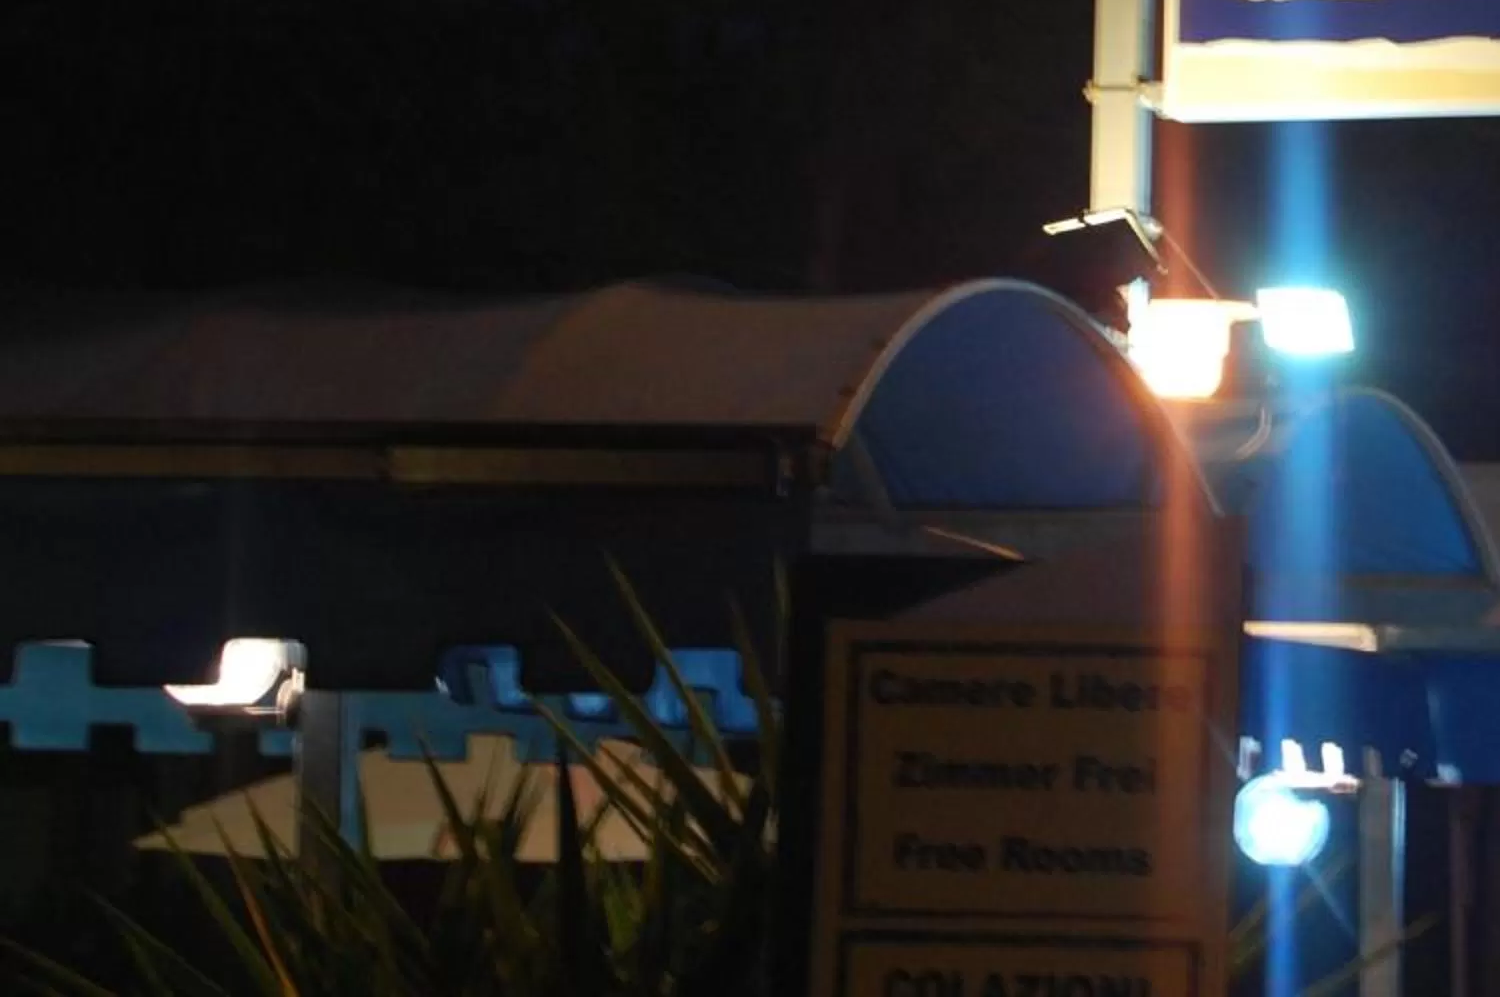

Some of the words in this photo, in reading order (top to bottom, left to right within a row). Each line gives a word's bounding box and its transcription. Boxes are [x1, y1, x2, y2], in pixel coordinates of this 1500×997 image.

[869, 669, 1037, 709] Camere
[891, 750, 1060, 790] Zimmer
[1073, 754, 1156, 795] Frei
[893, 831, 987, 873] Free
[1001, 835, 1153, 876] Rooms
